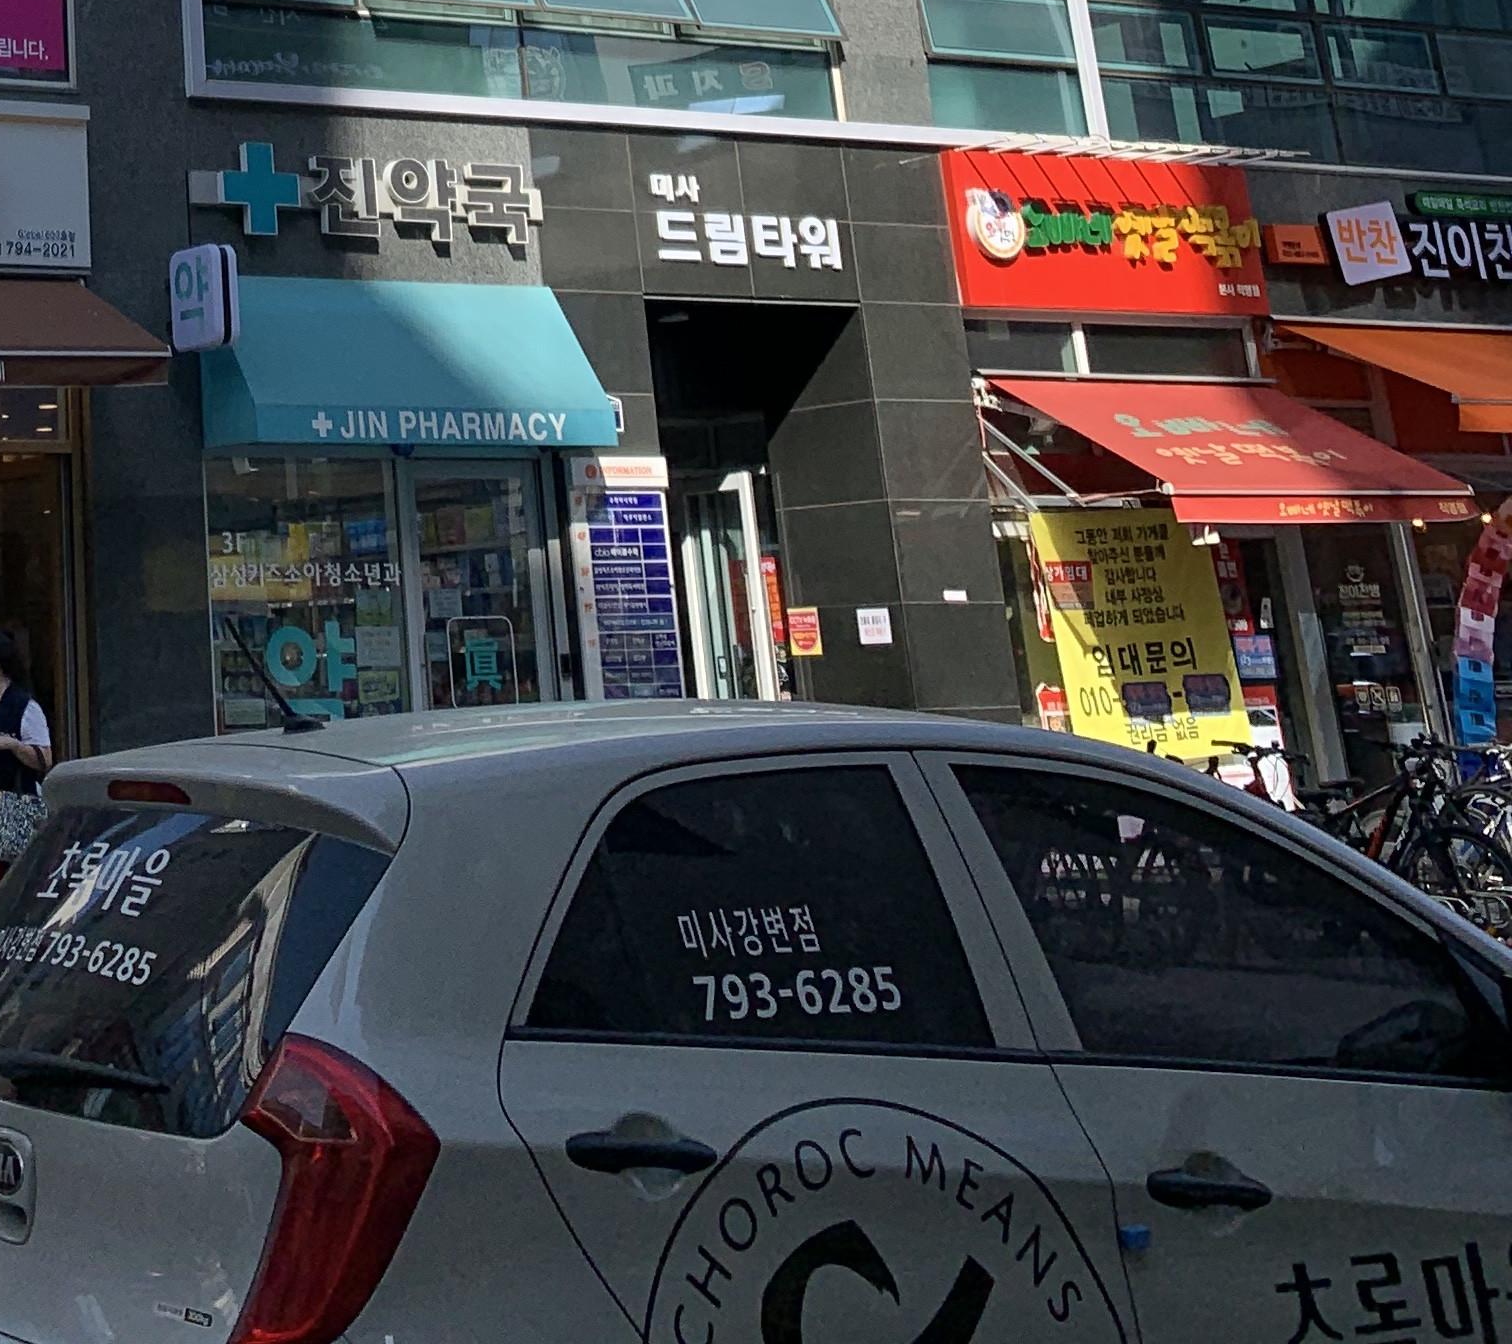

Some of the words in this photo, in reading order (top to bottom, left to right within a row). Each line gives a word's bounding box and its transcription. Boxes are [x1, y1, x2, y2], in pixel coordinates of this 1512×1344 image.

[308, 154, 544, 246] 진약국
[648, 173, 702, 205] 미사
[6, 241, 75, 257] 794-2021
[655, 209, 844, 272] 드림타워
[1336, 218, 1399, 265] 반찬
[340, 409, 389, 441] JIN
[399, 409, 567, 442] PHARMACY
[1074, 527, 1108, 545] 그동안
[1138, 524, 1168, 542] 가게를
[209, 561, 402, 588] 삼성키즈소아청소년과
[1104, 566, 1157, 585] 감사합니다
[1105, 589, 1128, 606] 내부
[1092, 636, 1197, 679] 임대문의
[1173, 716, 1200, 741] 없음
[37, 841, 171, 918] 초록마을
[678, 904, 821, 962] 미사강변점
[40, 929, 158, 986] 793-6285
[691, 965, 903, 1023] 793-6285
[674, 1128, 876, 1344] CHOROC
[904, 1133, 1083, 1324] MEANS
